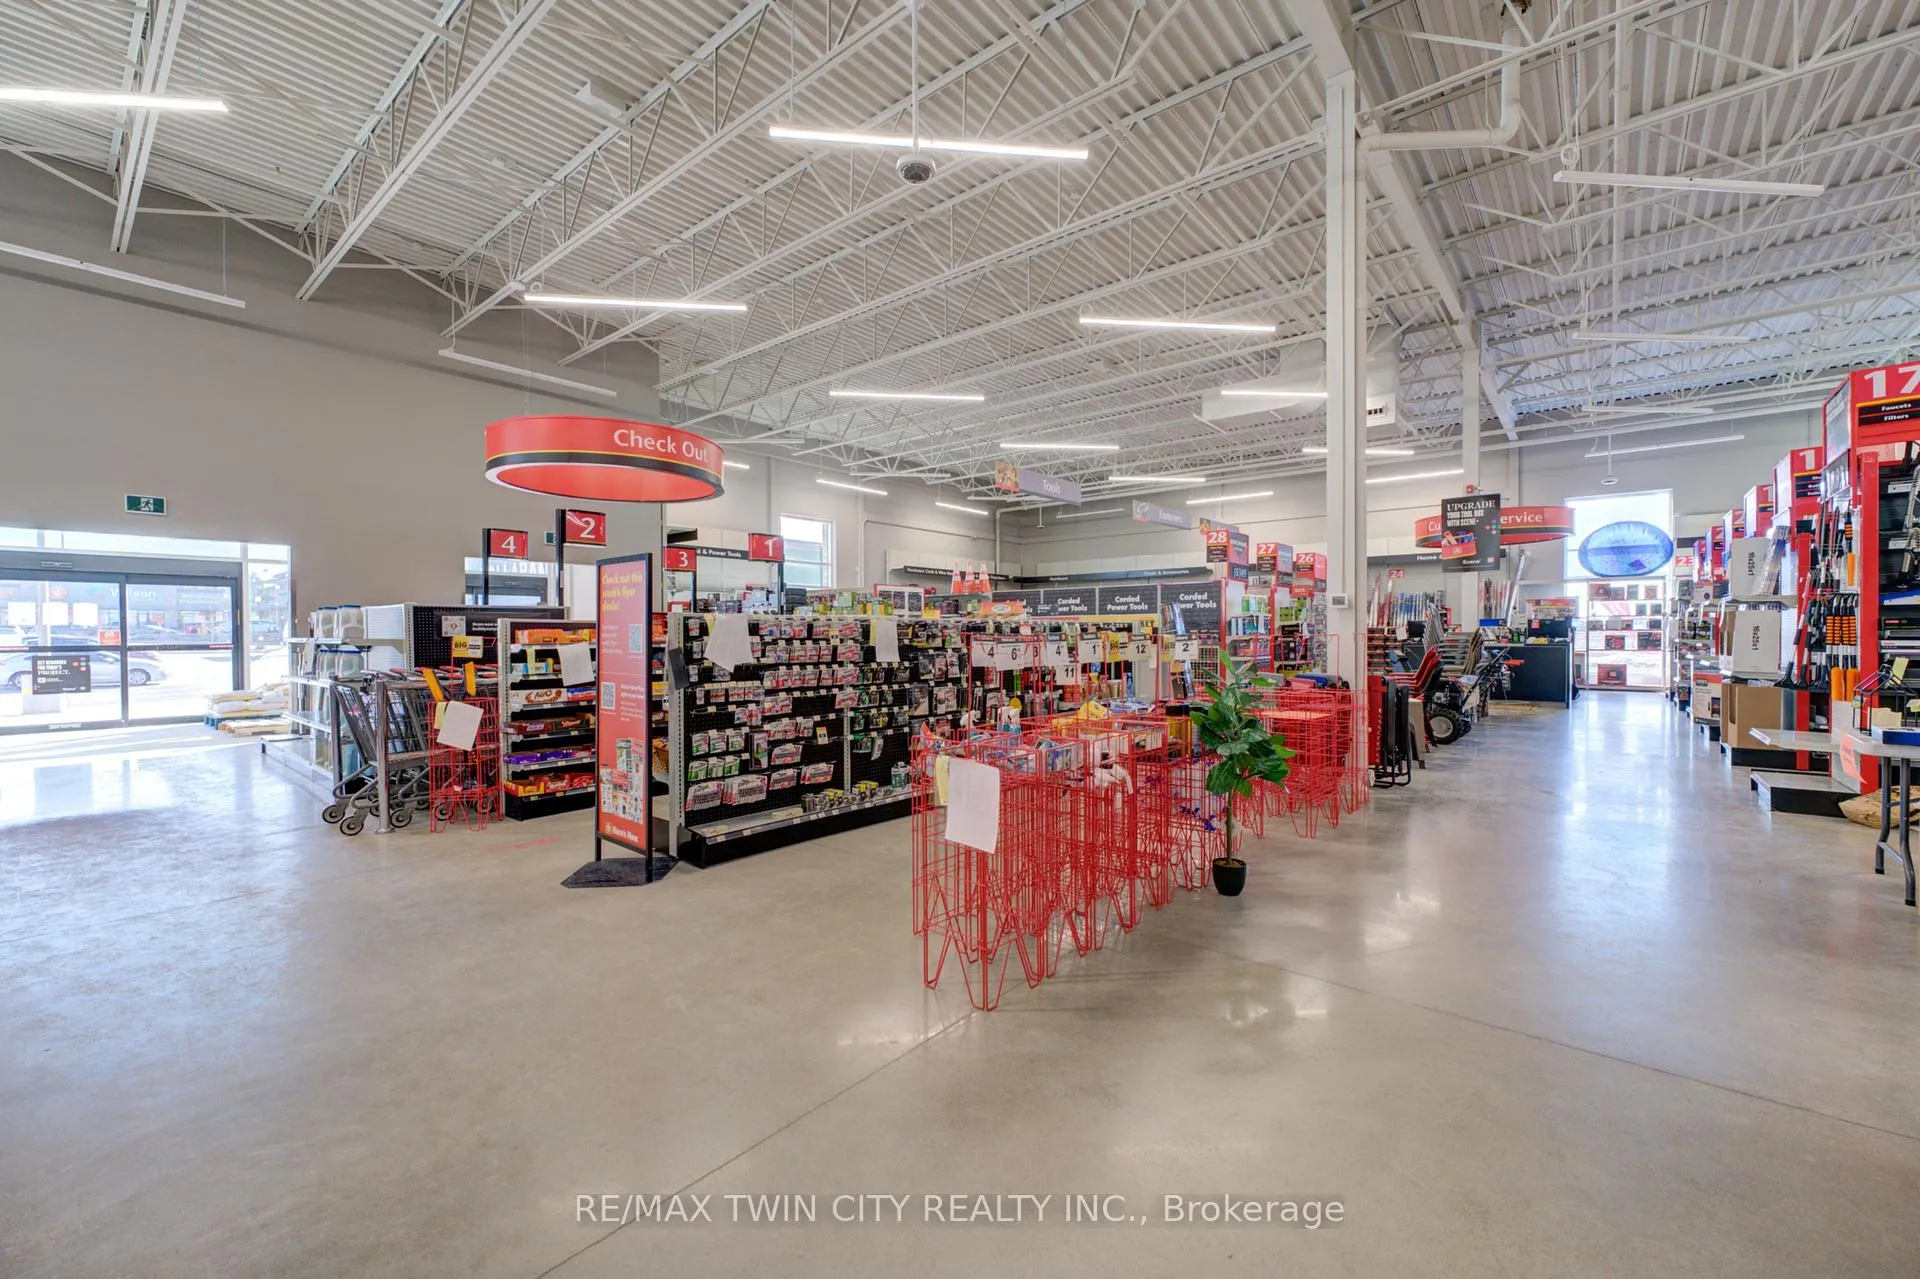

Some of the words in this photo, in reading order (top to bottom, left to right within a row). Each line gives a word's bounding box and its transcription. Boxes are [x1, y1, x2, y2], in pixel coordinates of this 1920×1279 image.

[1881, 402, 1912, 412] Faucets
[1883, 413, 1909, 421] Filters
[613, 428, 676, 455] Check
[682, 441, 708, 464] Out
[1042, 479, 1062, 495] Tools
[1446, 500, 1496, 511] UPGRADE
[1446, 511, 1461, 519] YOUR
[1461, 510, 1474, 518] TOOL
[1499, 511, 1543, 524] ervice
[579, 517, 597, 539] 2
[1446, 519, 1460, 527] WITH
[1208, 531, 1228, 544] 28
[501, 535, 516, 554] 4
[764, 537, 775, 557] 1
[1258, 543, 1276, 554] 27
[708, 549, 726, 557] Power
[727, 550, 741, 558] Tools
[1298, 553, 1314, 563] 26
[678, 551, 689, 567] 3
[602, 574, 619, 585] Check
[619, 574, 630, 583] out
[631, 571, 643, 582] this
[1391, 570, 1404, 578] 24
[621, 585, 636, 599] flyer
[1179, 592, 1208, 601] Corded
[1057, 596, 1081, 605] Corded
[1114, 594, 1140, 603] Corded
[1070, 604, 1088, 612] Tools
[1107, 603, 1128, 611] Power
[1129, 602, 1148, 610] Tools
[1195, 600, 1217, 608] Tools
[454, 641, 467, 649] BIG
[1135, 643, 1146, 654] 12
[1064, 666, 1075, 678] 11
